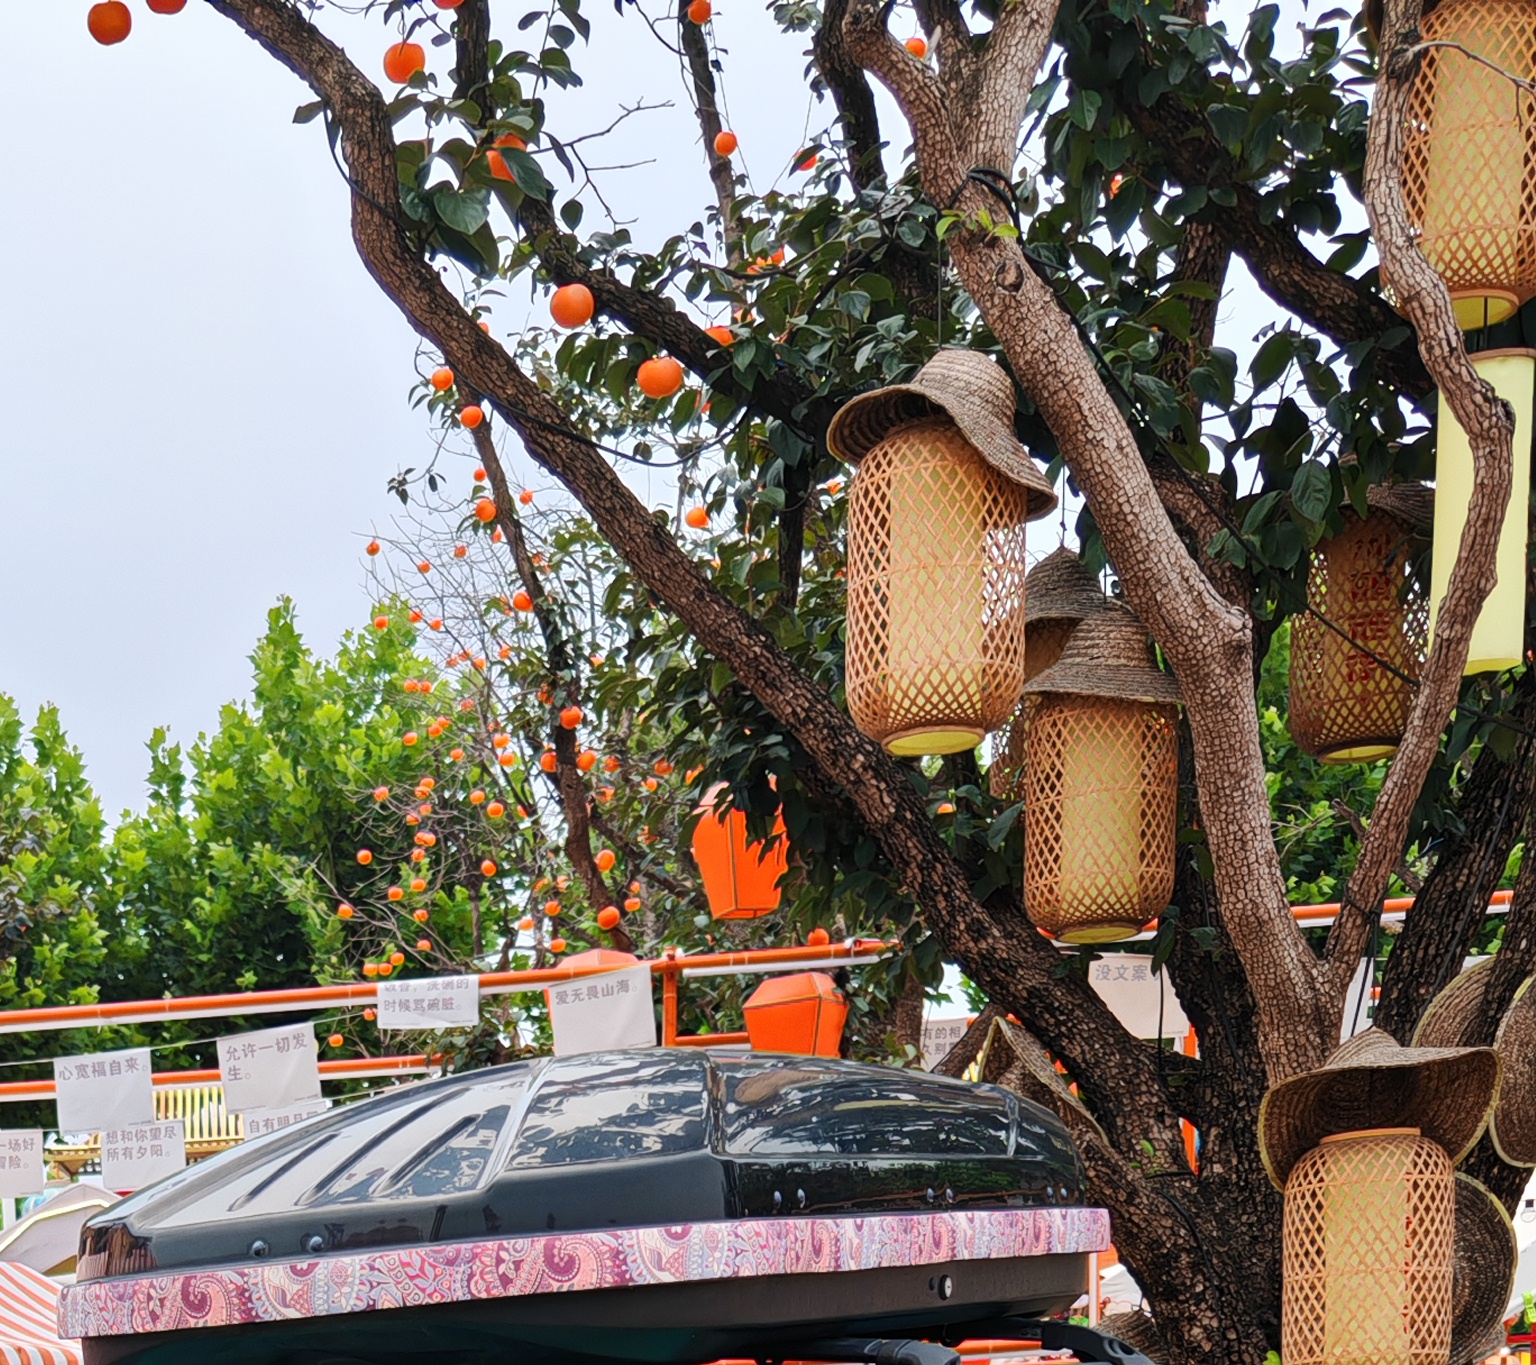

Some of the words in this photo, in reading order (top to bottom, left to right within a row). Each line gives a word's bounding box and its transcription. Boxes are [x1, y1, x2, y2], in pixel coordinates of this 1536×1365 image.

[1095, 964, 1161, 982] 没文案
[555, 977, 638, 1006] 爱无畏山海。
[383, 997, 462, 1013] 时候骂碗脏。
[225, 1032, 308, 1062] 允许一切发
[58, 1056, 148, 1082] 心宽福自来。
[227, 1063, 252, 1082] 生。
[105, 1124, 177, 1145] 想和你望尽
[106, 1144, 171, 1162] 所有夕阳。
